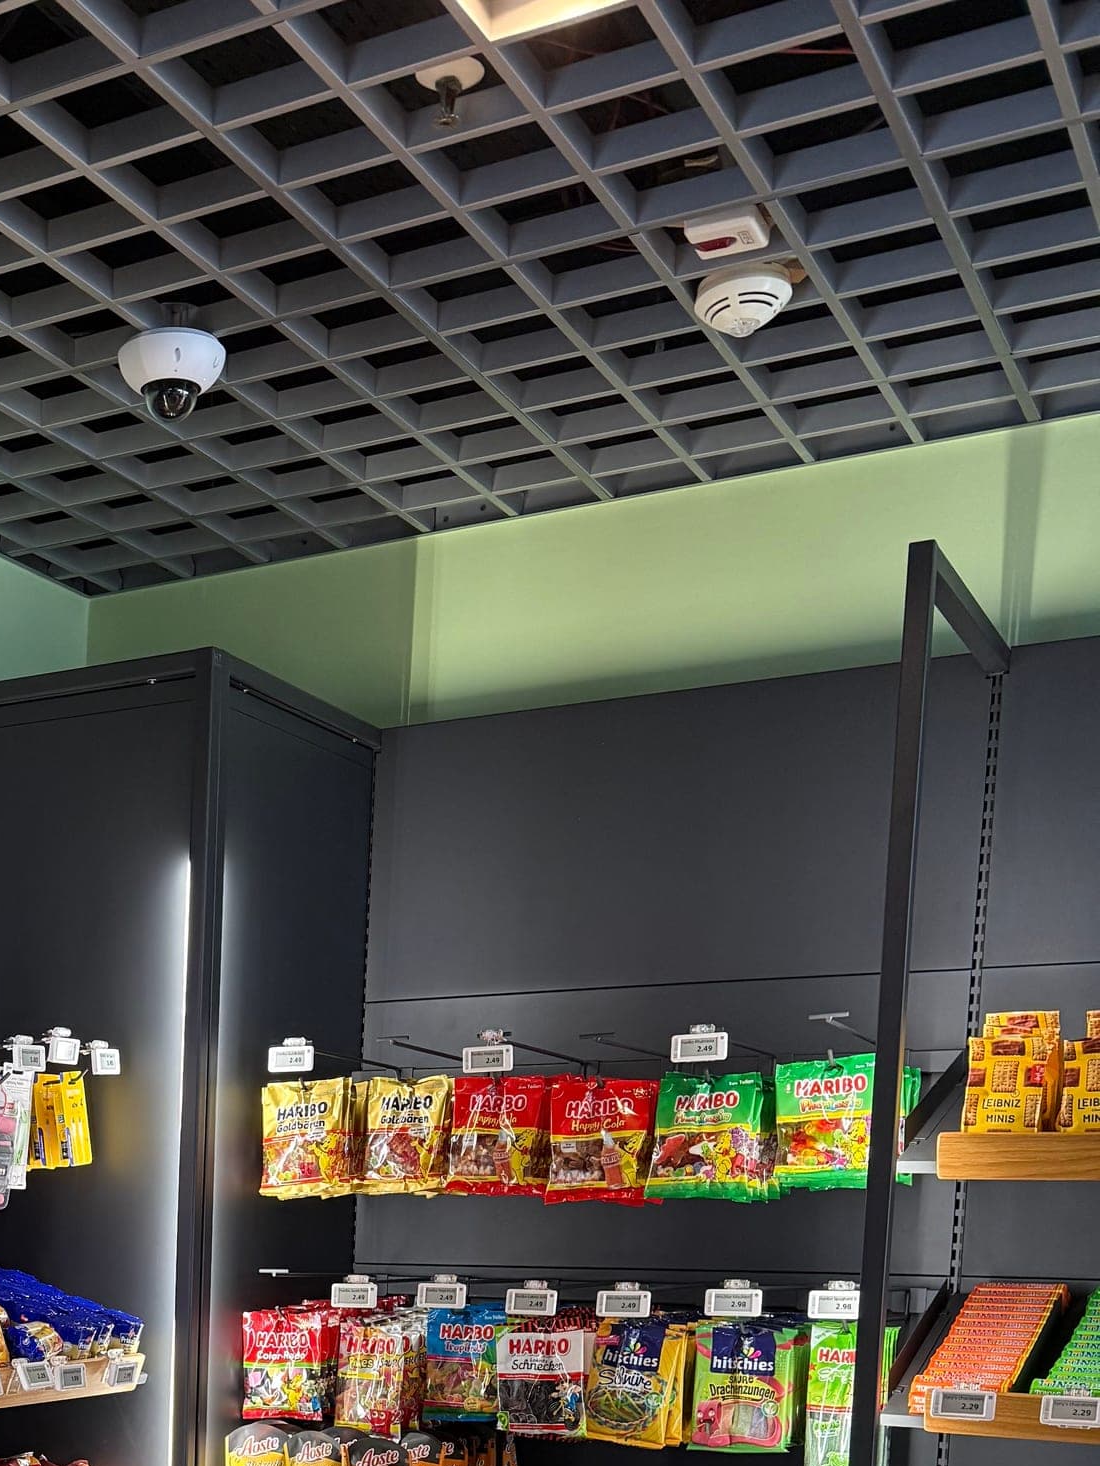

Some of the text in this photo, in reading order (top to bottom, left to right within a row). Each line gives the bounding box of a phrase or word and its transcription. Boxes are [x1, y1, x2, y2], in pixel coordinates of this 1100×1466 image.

[697, 1044, 713, 1053] 2.49
[794, 1074, 867, 1097] HARIBO
[675, 1091, 739, 1112] HARIBO
[982, 1098, 1021, 1109] LEIBNIZ
[1078, 1098, 1100, 1109] LEIB
[277, 1101, 328, 1121] HARIBO
[565, 1098, 634, 1119] HARIBO
[571, 1119, 625, 1131] Happy Cola
[986, 1114, 1016, 1124] MINIS
[1083, 1114, 1100, 1123] MIN
[276, 1119, 326, 1134] Goldbären
[529, 1300, 543, 1308] 2.49
[835, 1302, 852, 1310] 2.98
[256, 1331, 310, 1348] HARIBO
[511, 1359, 565, 1371] Schnecken
[712, 1354, 774, 1371] hitschies
[709, 1383, 776, 1400] Drachenzungen
[1072, 1408, 1091, 1417] 2.29
[236, 1436, 279, 1457] Aoste
[297, 1442, 332, 1462] Aoste
